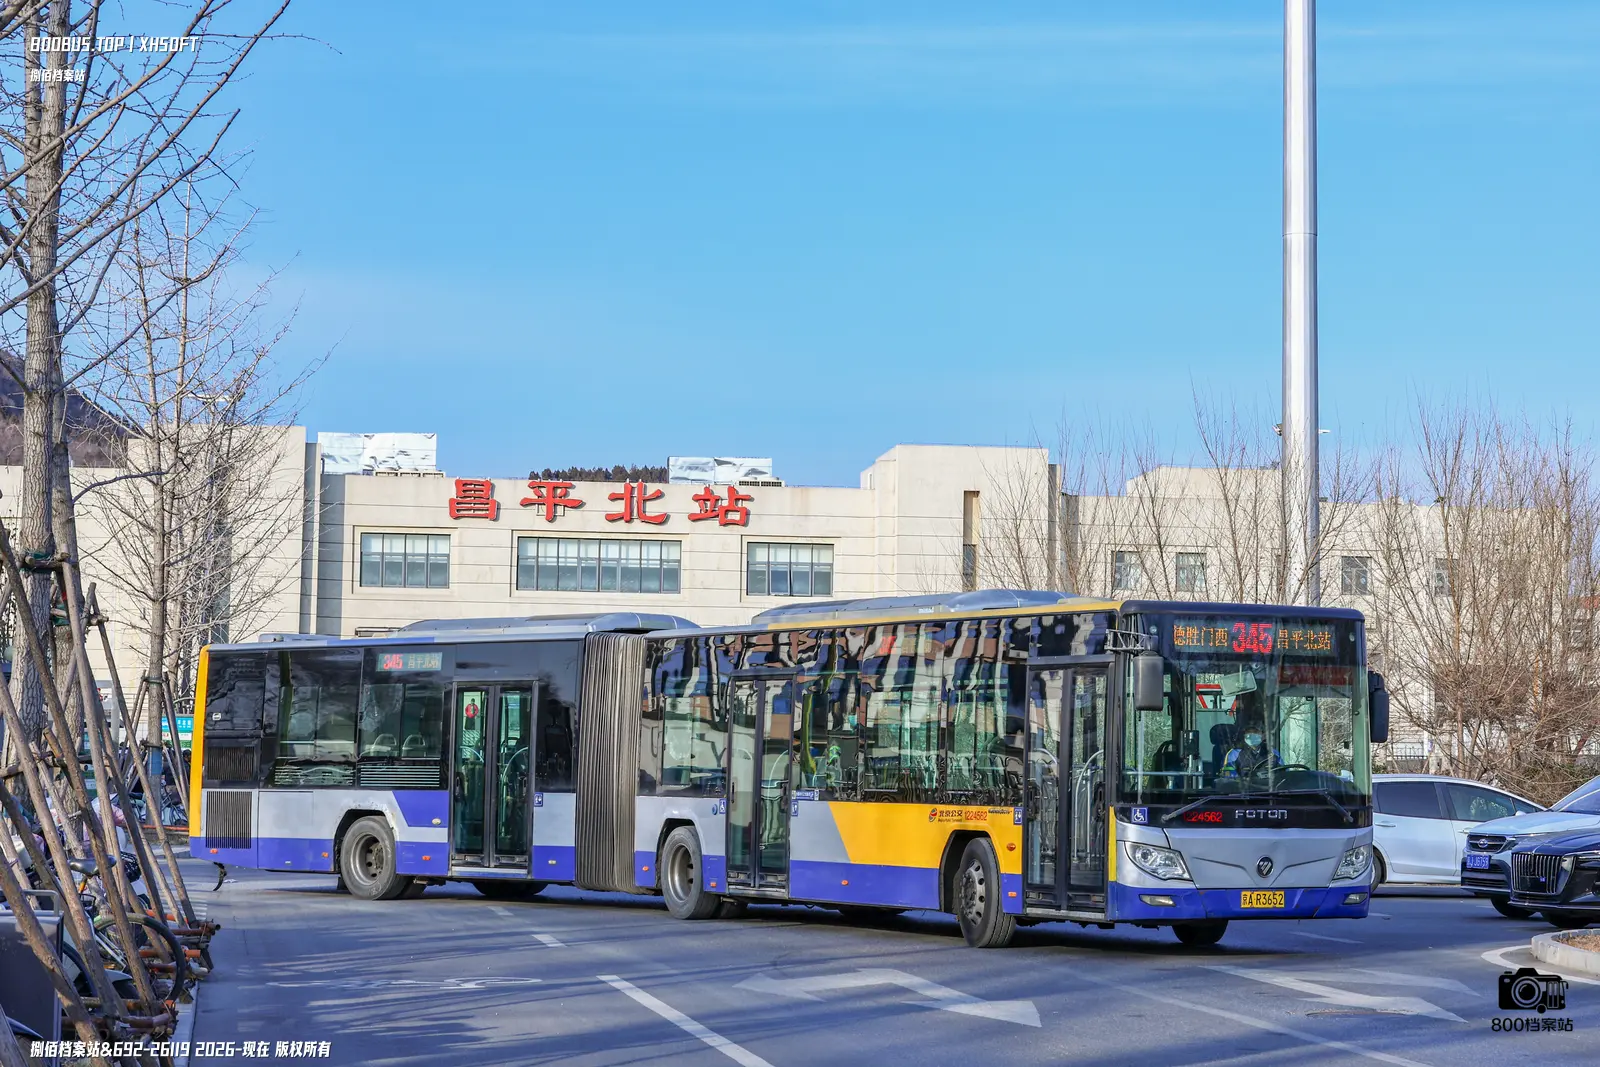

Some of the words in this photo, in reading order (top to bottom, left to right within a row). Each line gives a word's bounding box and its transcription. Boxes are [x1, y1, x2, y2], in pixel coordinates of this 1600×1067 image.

[449, 478, 754, 527] 昌平北站
[1173, 625, 1229, 647] 德胜门西
[1232, 622, 1273, 653] 345
[1277, 628, 1332, 650] 昌平北站
